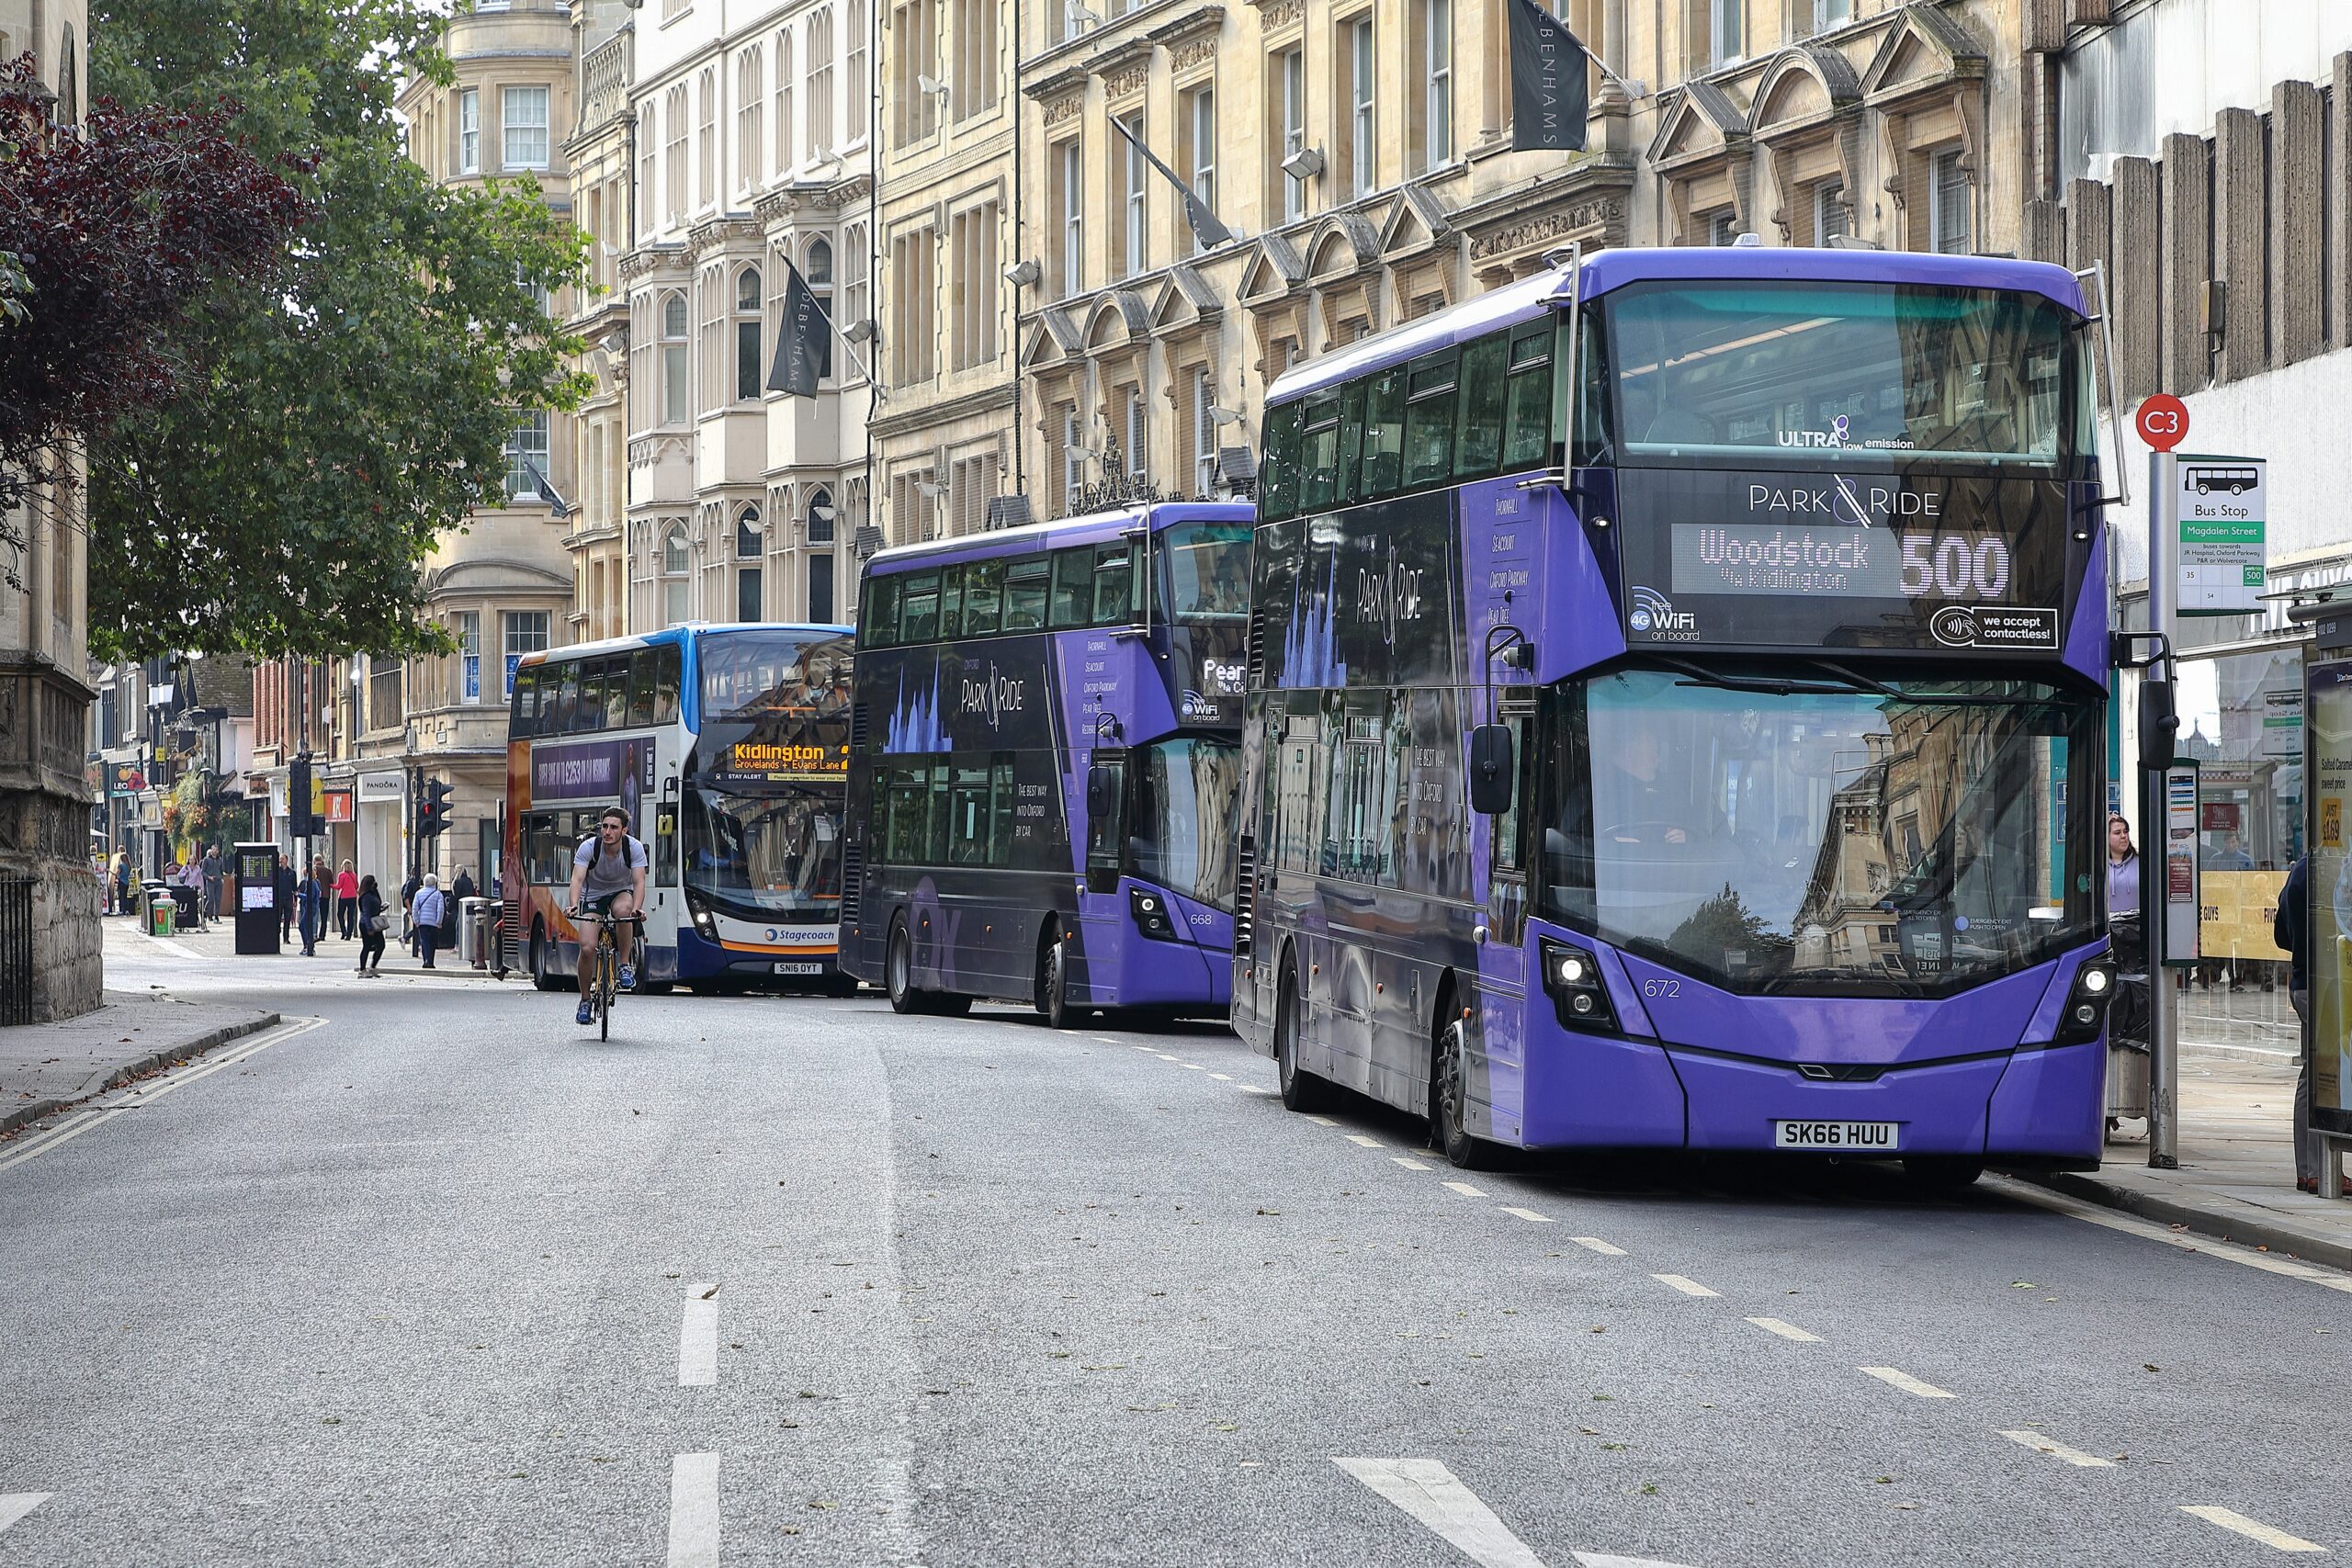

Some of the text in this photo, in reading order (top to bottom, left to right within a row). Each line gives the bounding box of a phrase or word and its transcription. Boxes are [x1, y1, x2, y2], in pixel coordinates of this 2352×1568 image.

[787, 292, 811, 390] DEBENHAMS
[2144, 411, 2178, 434] C3
[1778, 431, 1915, 451] ULTRA low emission
[1749, 484, 1831, 513] PARK
[1870, 488, 1940, 516] RIDE
[2195, 504, 2248, 519] Bus Stop
[2187, 526, 2257, 537] Magdalen Street
[1700, 529, 2009, 597] Woodstock 500
[1748, 569, 1848, 592] Kidlington
[2246, 571, 2261, 580] 500
[1651, 600, 1672, 612] free
[1631, 613, 1695, 629] 4G WiFi
[2005, 616, 2041, 627] accept
[1651, 630, 1700, 641] on board
[1984, 628, 2051, 639] contactless!
[1204, 659, 1246, 681] Pear
[1194, 705, 1218, 715] WiFi
[735, 744, 824, 761] Kidlington
[735, 760, 780, 770] Grovelands
[792, 760, 817, 770] Evans
[820, 760, 840, 770] Lane
[2335, 758, 2352, 771] Carame
[565, 760, 581, 785] £253
[332, 795, 343, 819] KFC
[1190, 914, 1212, 925] 668
[2204, 906, 2219, 921] GUYS
[779, 930, 834, 942] Stagecoach
[779, 964, 817, 973] SN16 OYT
[1644, 979, 1680, 998] 672
[1785, 1122, 1889, 1145] SK66 HUU
